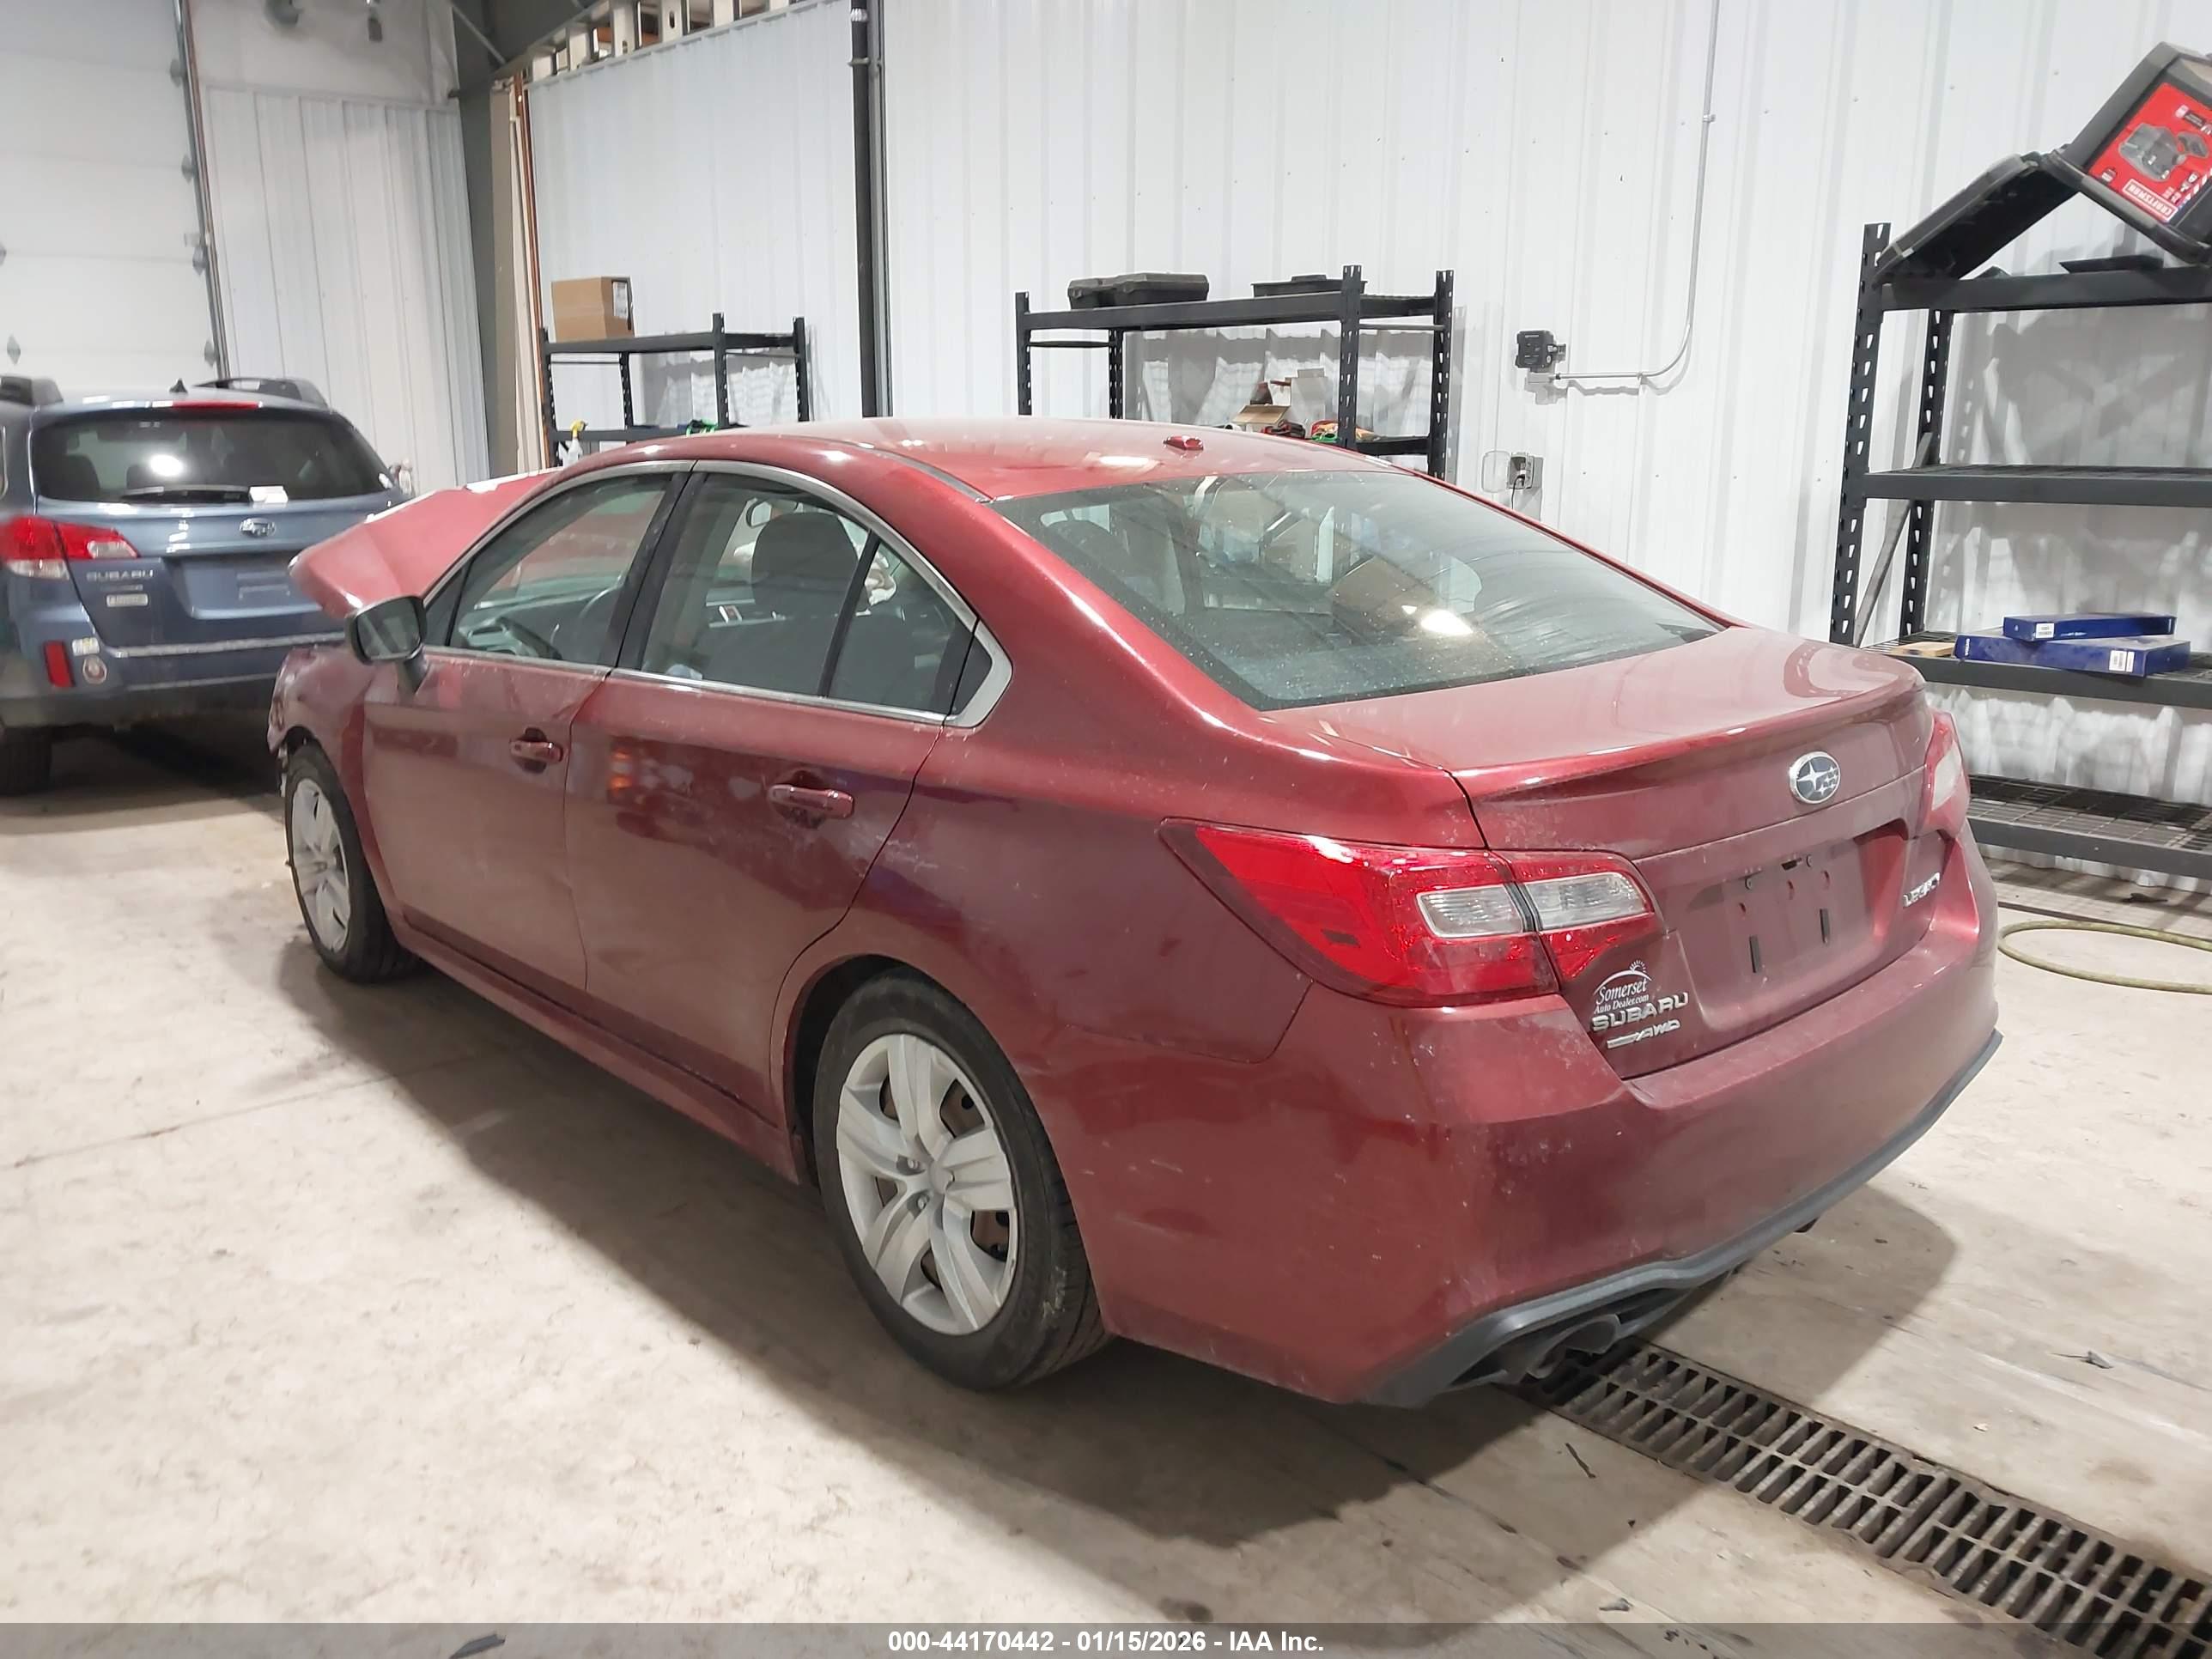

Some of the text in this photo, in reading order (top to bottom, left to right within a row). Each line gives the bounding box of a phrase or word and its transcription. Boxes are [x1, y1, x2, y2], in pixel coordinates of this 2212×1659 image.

[2127, 183, 2172, 217] CRAFTSMAN
[86, 569, 155, 582] SUBARU
[1595, 978, 1648, 1006] Somerset
[1592, 992, 1689, 1031] SUBARU
[1594, 1004, 1611, 1015] Auto
[1641, 1019, 1680, 1039] AWD
